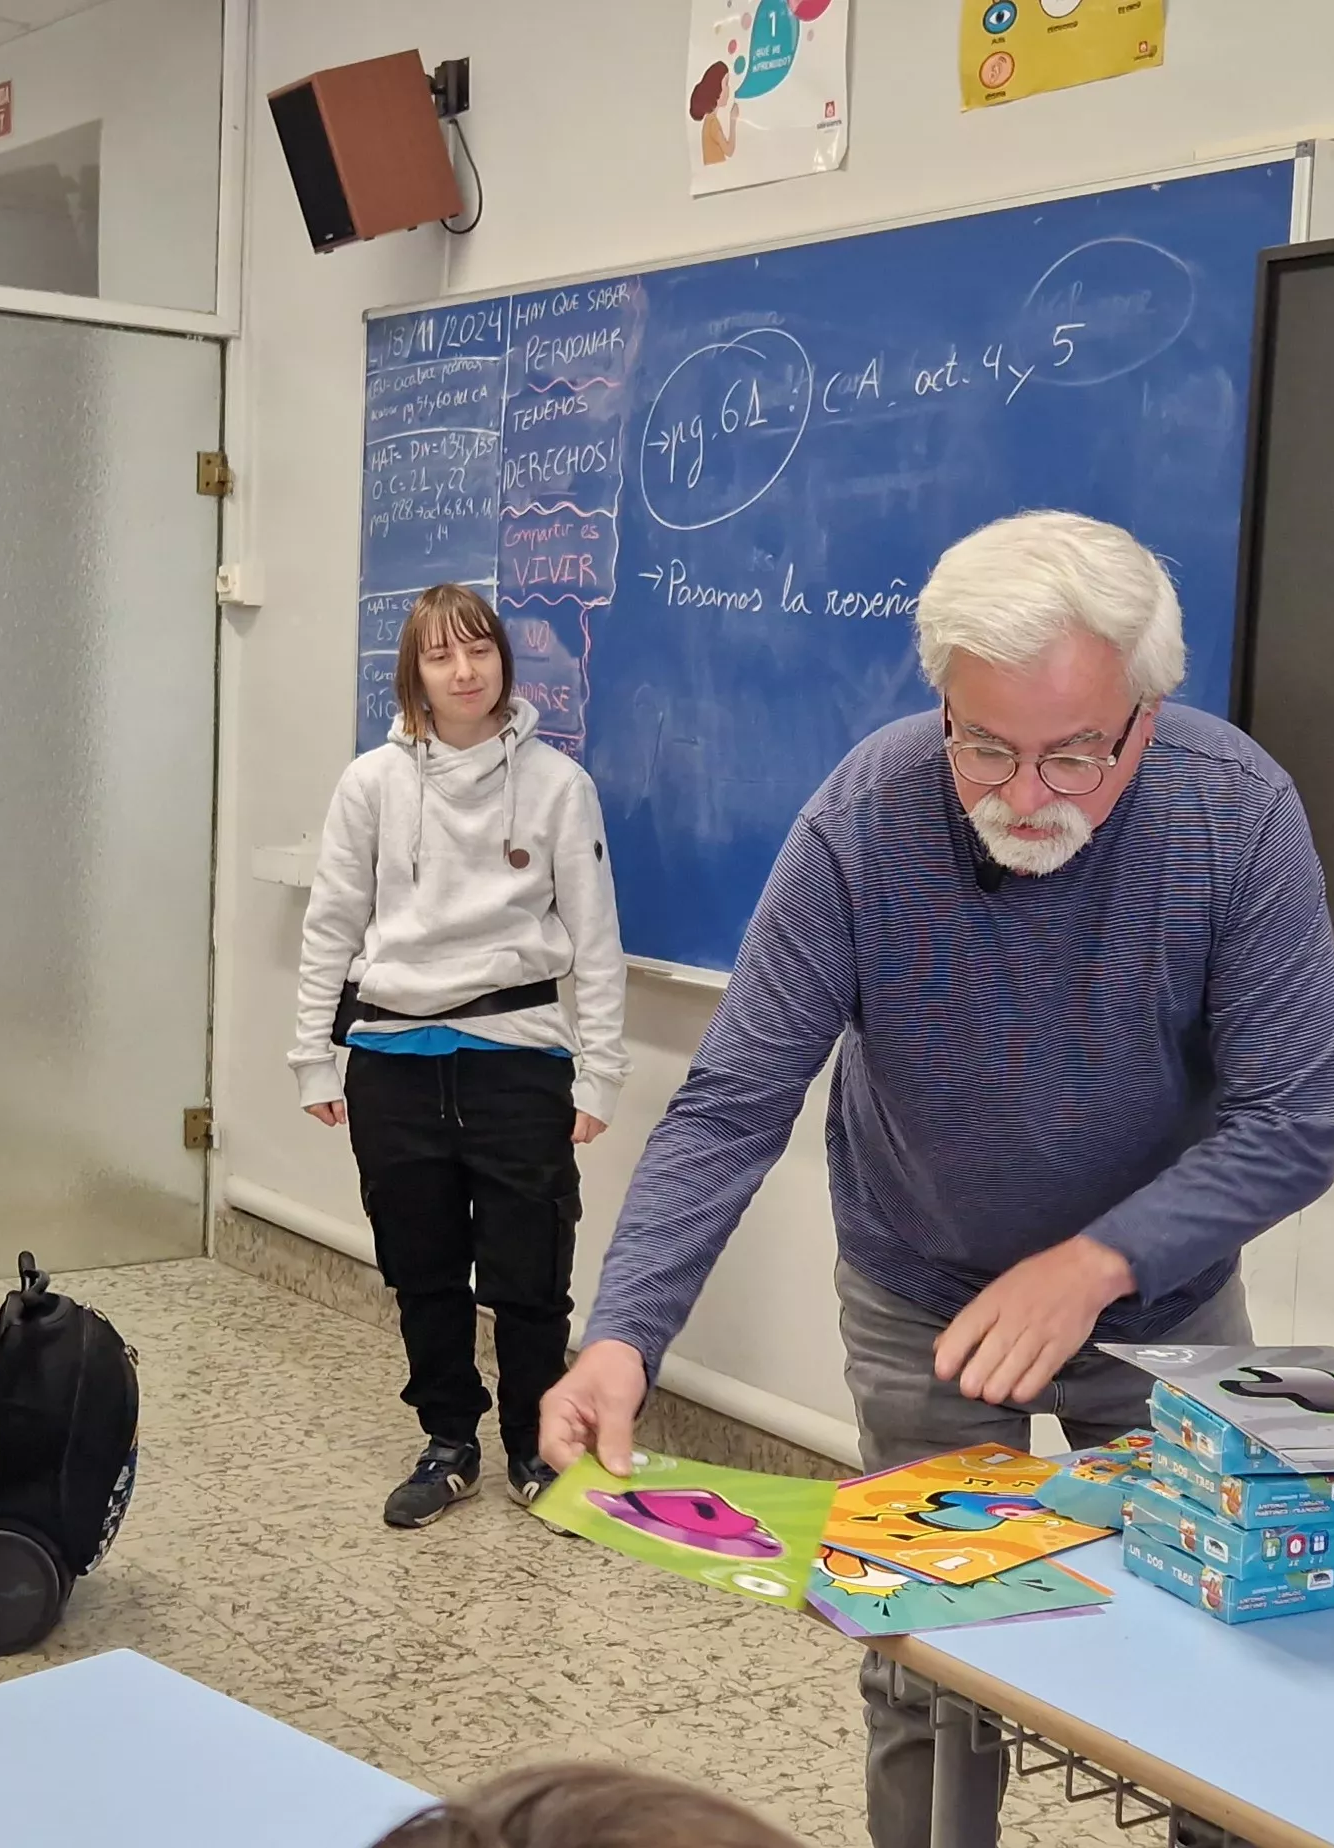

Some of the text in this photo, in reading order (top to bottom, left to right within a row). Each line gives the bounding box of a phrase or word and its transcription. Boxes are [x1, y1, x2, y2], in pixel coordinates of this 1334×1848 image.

[515, 299, 547, 330] HAY
[587, 282, 630, 312] SABER
[525, 327, 624, 374] PERDONAR
[982, 343, 1003, 379] 4
[1008, 363, 1035, 405] y
[1053, 322, 1086, 366] 5
[513, 395, 588, 433] TENEMOS
[581, 523, 599, 539] es
[514, 554, 597, 588] VIVIR
[667, 558, 763, 612] Pasamos
[781, 562, 813, 614] la
[526, 620, 550, 653] NO
